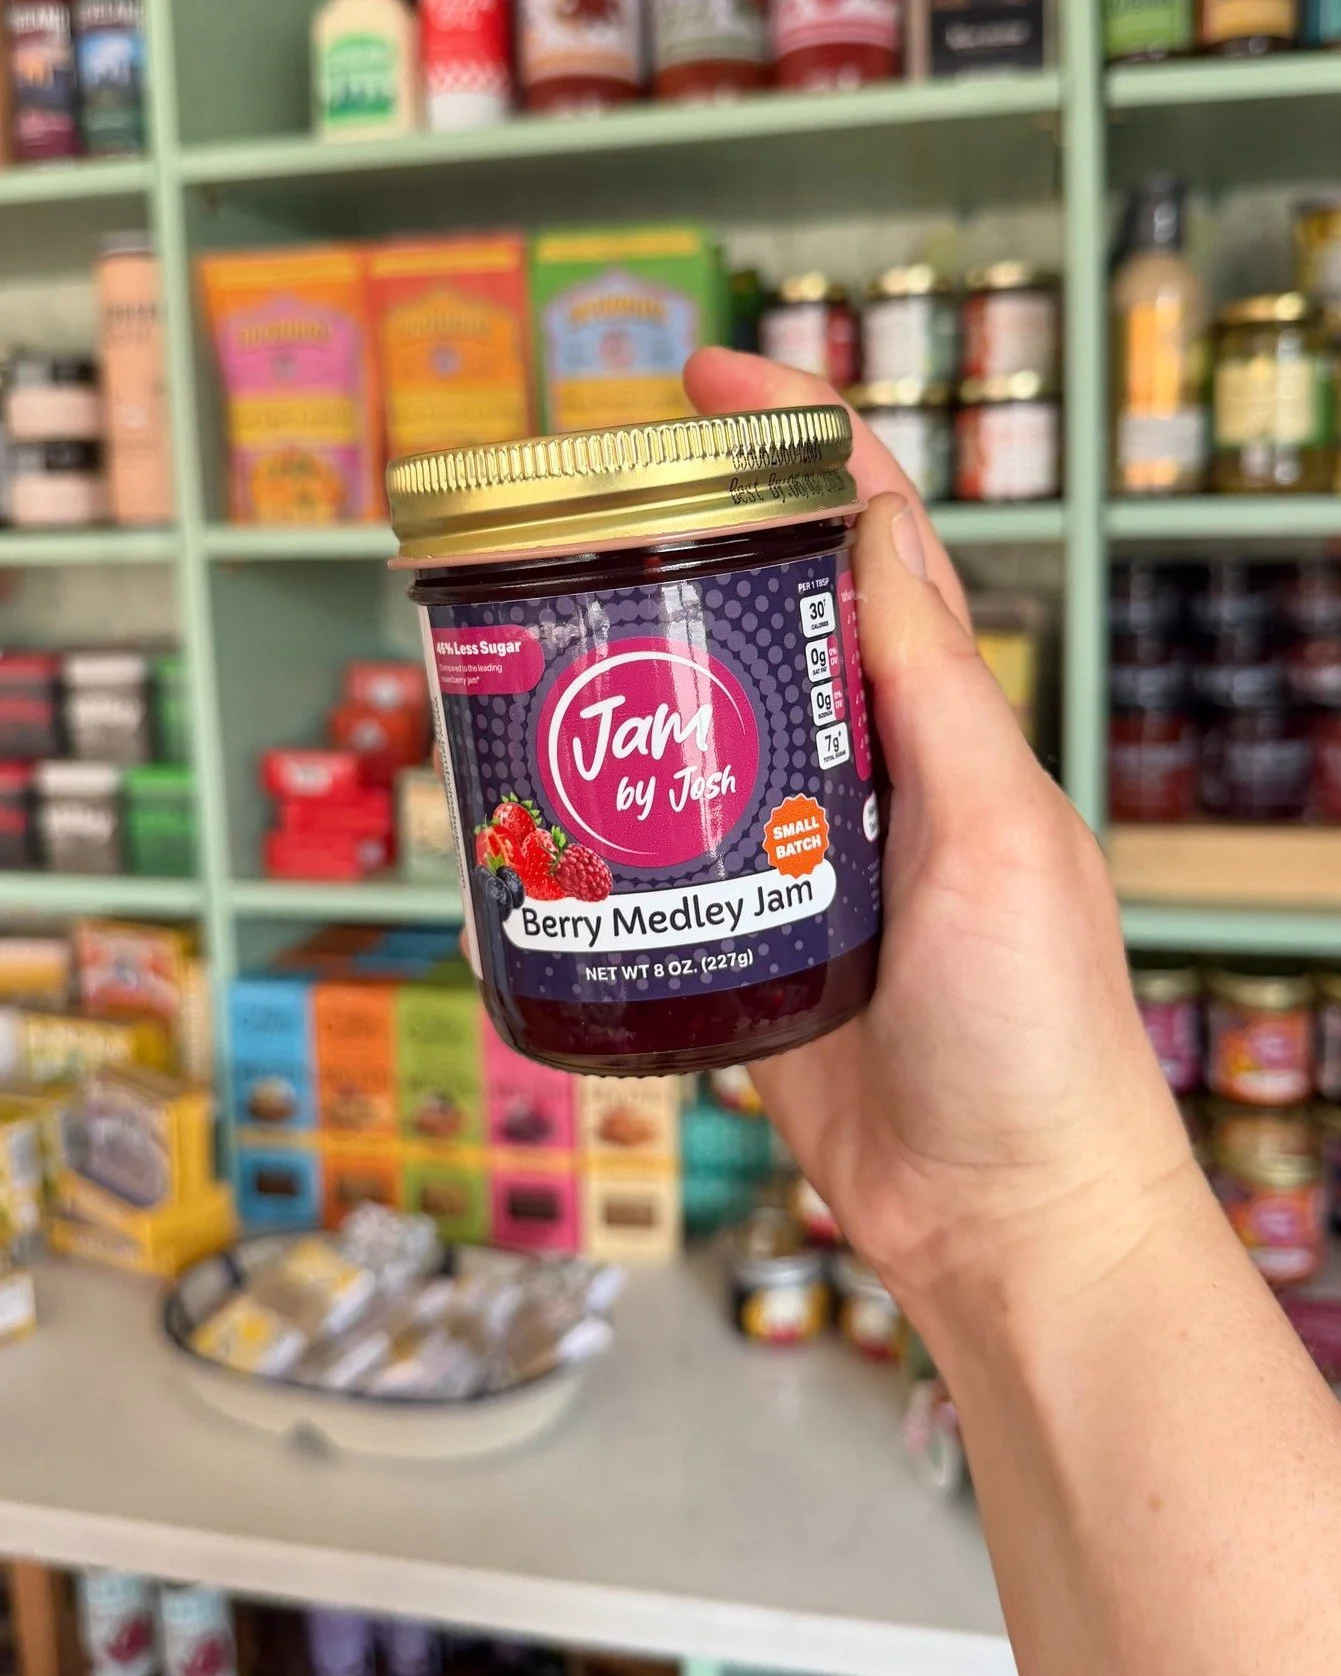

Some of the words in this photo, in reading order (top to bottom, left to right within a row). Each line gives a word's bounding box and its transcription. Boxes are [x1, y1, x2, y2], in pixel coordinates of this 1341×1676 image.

[729, 477, 764, 505] Best
[797, 583, 811, 593] PER
[815, 577, 830, 588] TBSP
[437, 641, 454, 655] 46%
[454, 641, 479, 656] Less
[479, 640, 522, 657] Sugar
[811, 647, 826, 667] 0g
[477, 662, 503, 674] leading
[816, 691, 832, 711] 0g
[572, 695, 714, 782] Jam
[616, 775, 657, 822] by
[668, 764, 736, 813] Josh
[772, 815, 820, 840] SMALL
[775, 834, 822, 860] BATCH
[521, 906, 602, 948] Berry
[612, 895, 745, 936] Medley
[753, 878, 814, 917] Jam
[585, 966, 618, 981] NET
[621, 964, 650, 980] WT
[653, 963, 665, 977] 8
[669, 960, 698, 976] OZ.
[701, 949, 754, 973] (227g)
